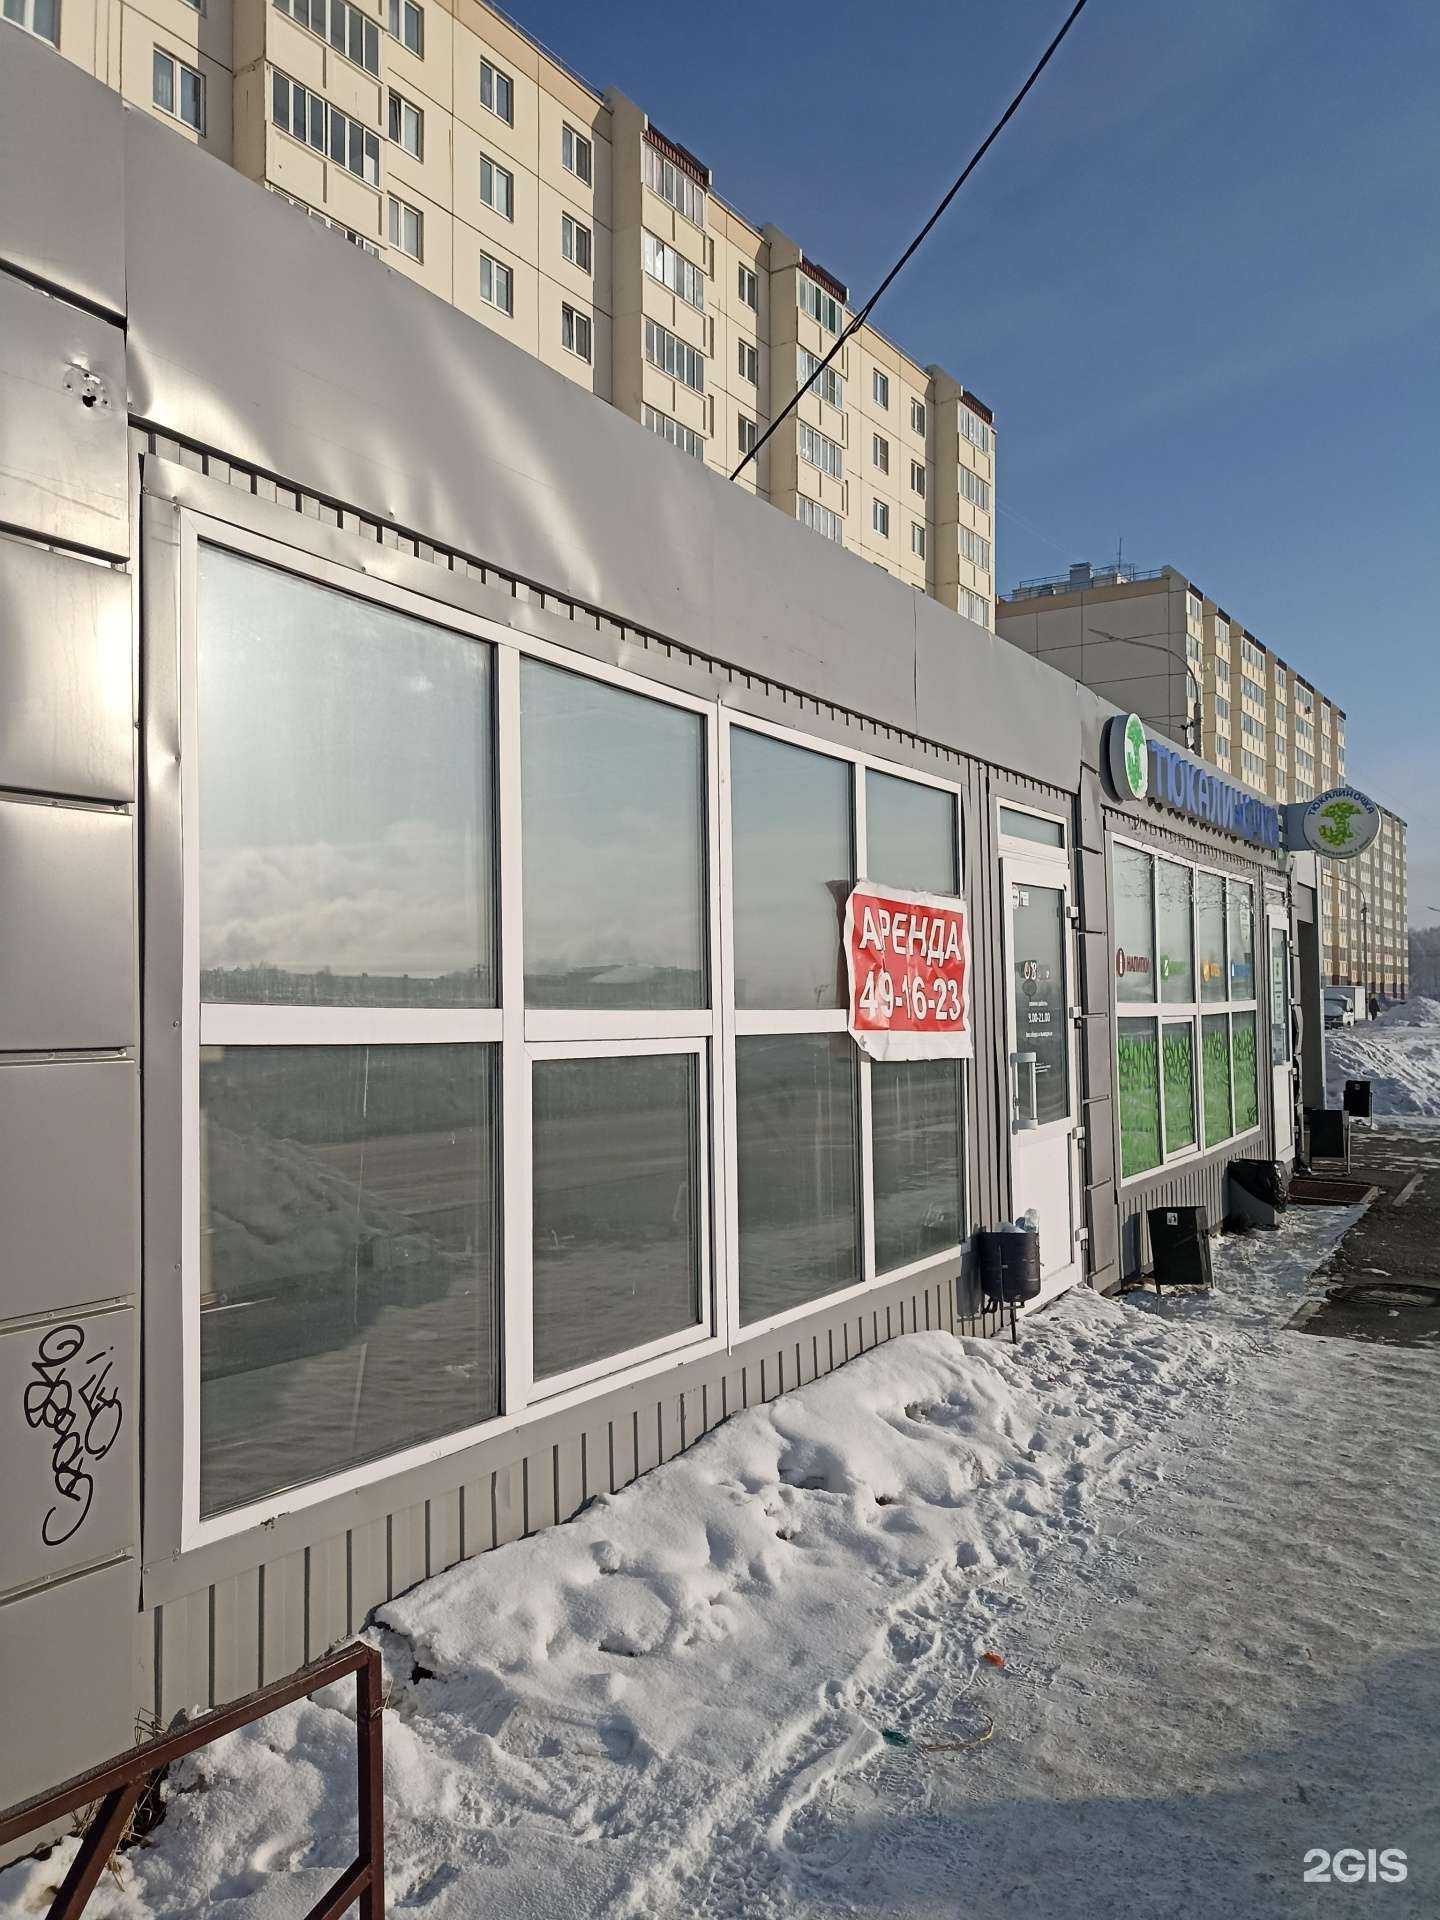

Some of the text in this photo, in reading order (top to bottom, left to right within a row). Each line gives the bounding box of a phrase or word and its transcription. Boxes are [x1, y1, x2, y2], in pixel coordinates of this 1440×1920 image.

[1308, 789, 1375, 815] ТЮКАЛИНОЧКА
[859, 906, 962, 967] АРЕНДА
[859, 970, 961, 1020] 49-16-23
